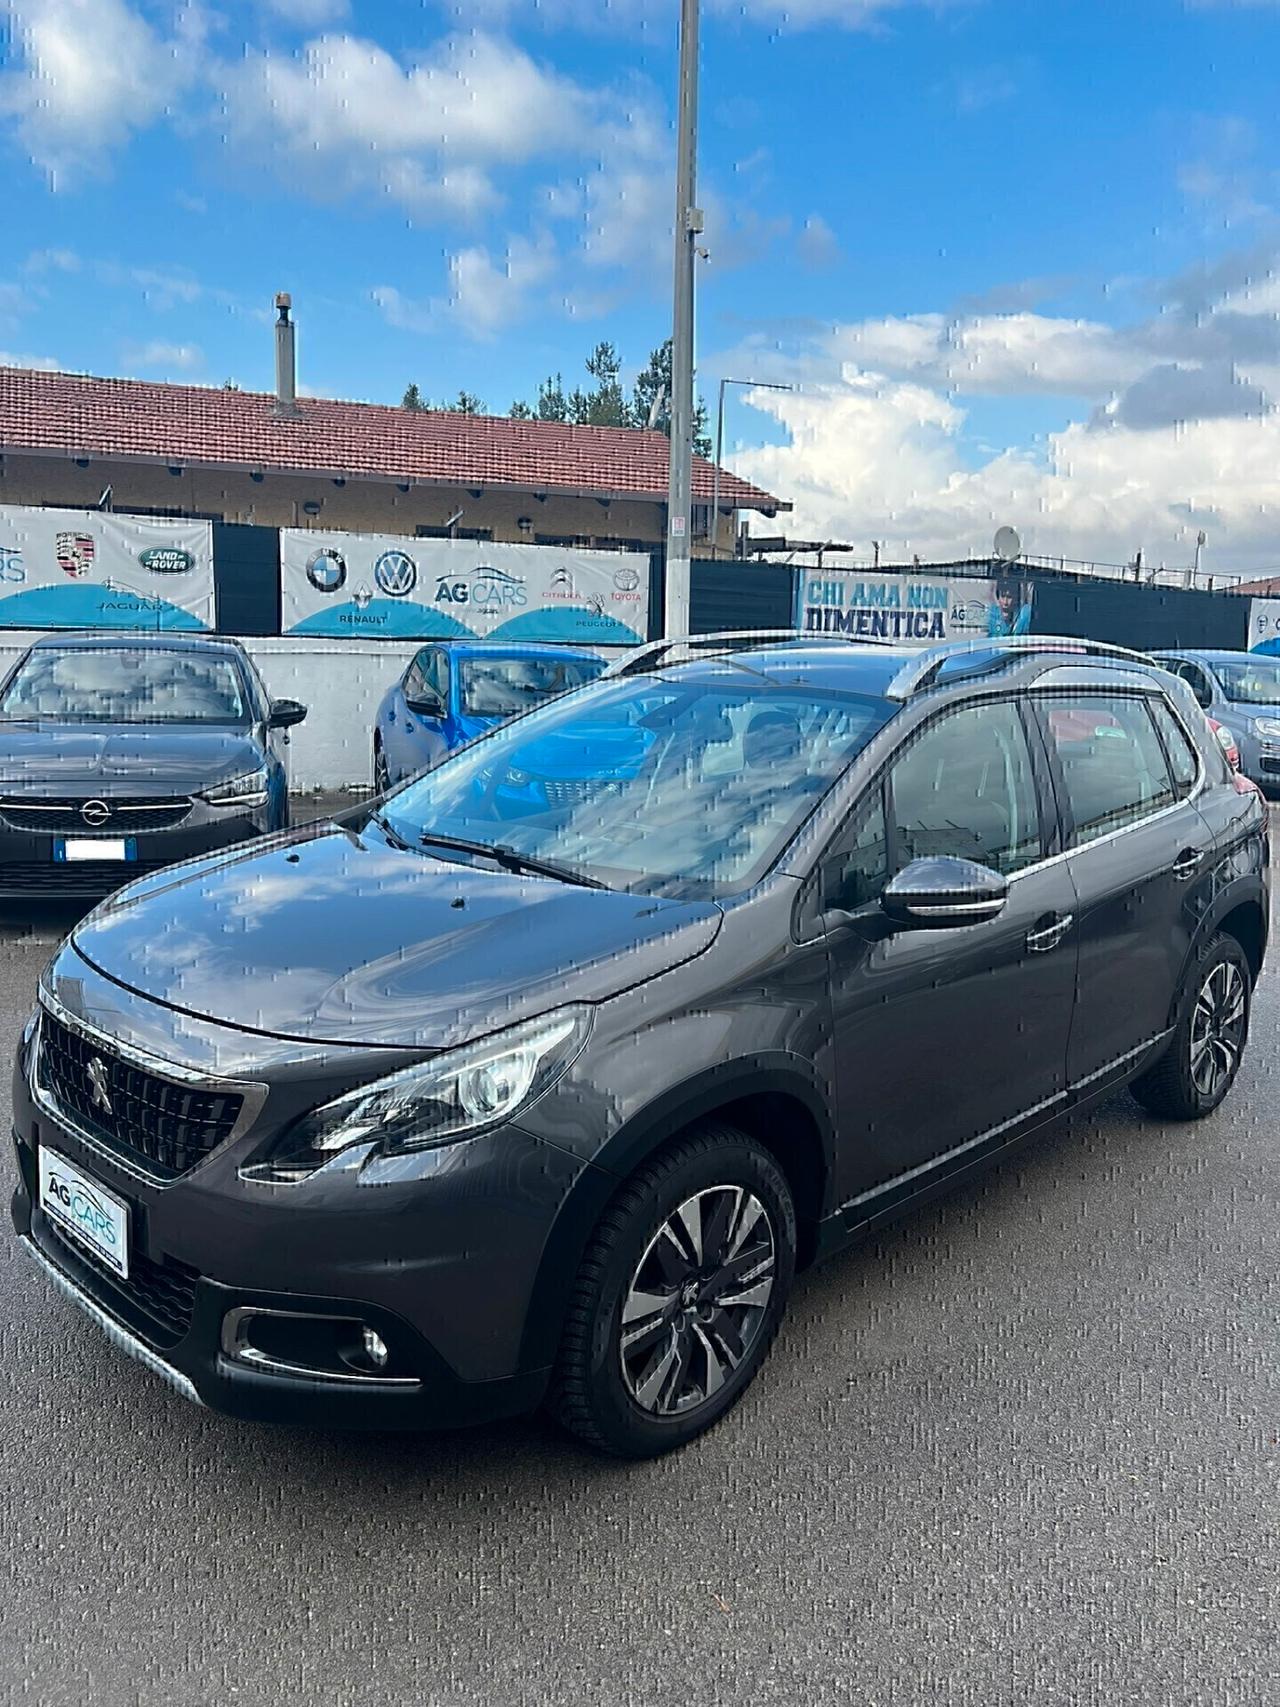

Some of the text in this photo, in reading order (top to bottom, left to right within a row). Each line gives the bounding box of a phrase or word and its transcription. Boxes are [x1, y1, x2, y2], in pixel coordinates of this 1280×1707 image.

[149, 550, 178, 560] LAND
[151, 560, 186, 569] ROVER
[472, 584, 528, 606] CARS
[610, 592, 641, 601] TOYOTA
[807, 581, 948, 609] CHI AMA NON
[96, 602, 162, 610] JAGUAR
[340, 615, 387, 624] RENAULT
[806, 607, 946, 639] DIMENTICA
[48, 1177, 71, 1207] AG
[72, 1196, 116, 1245] CARS
